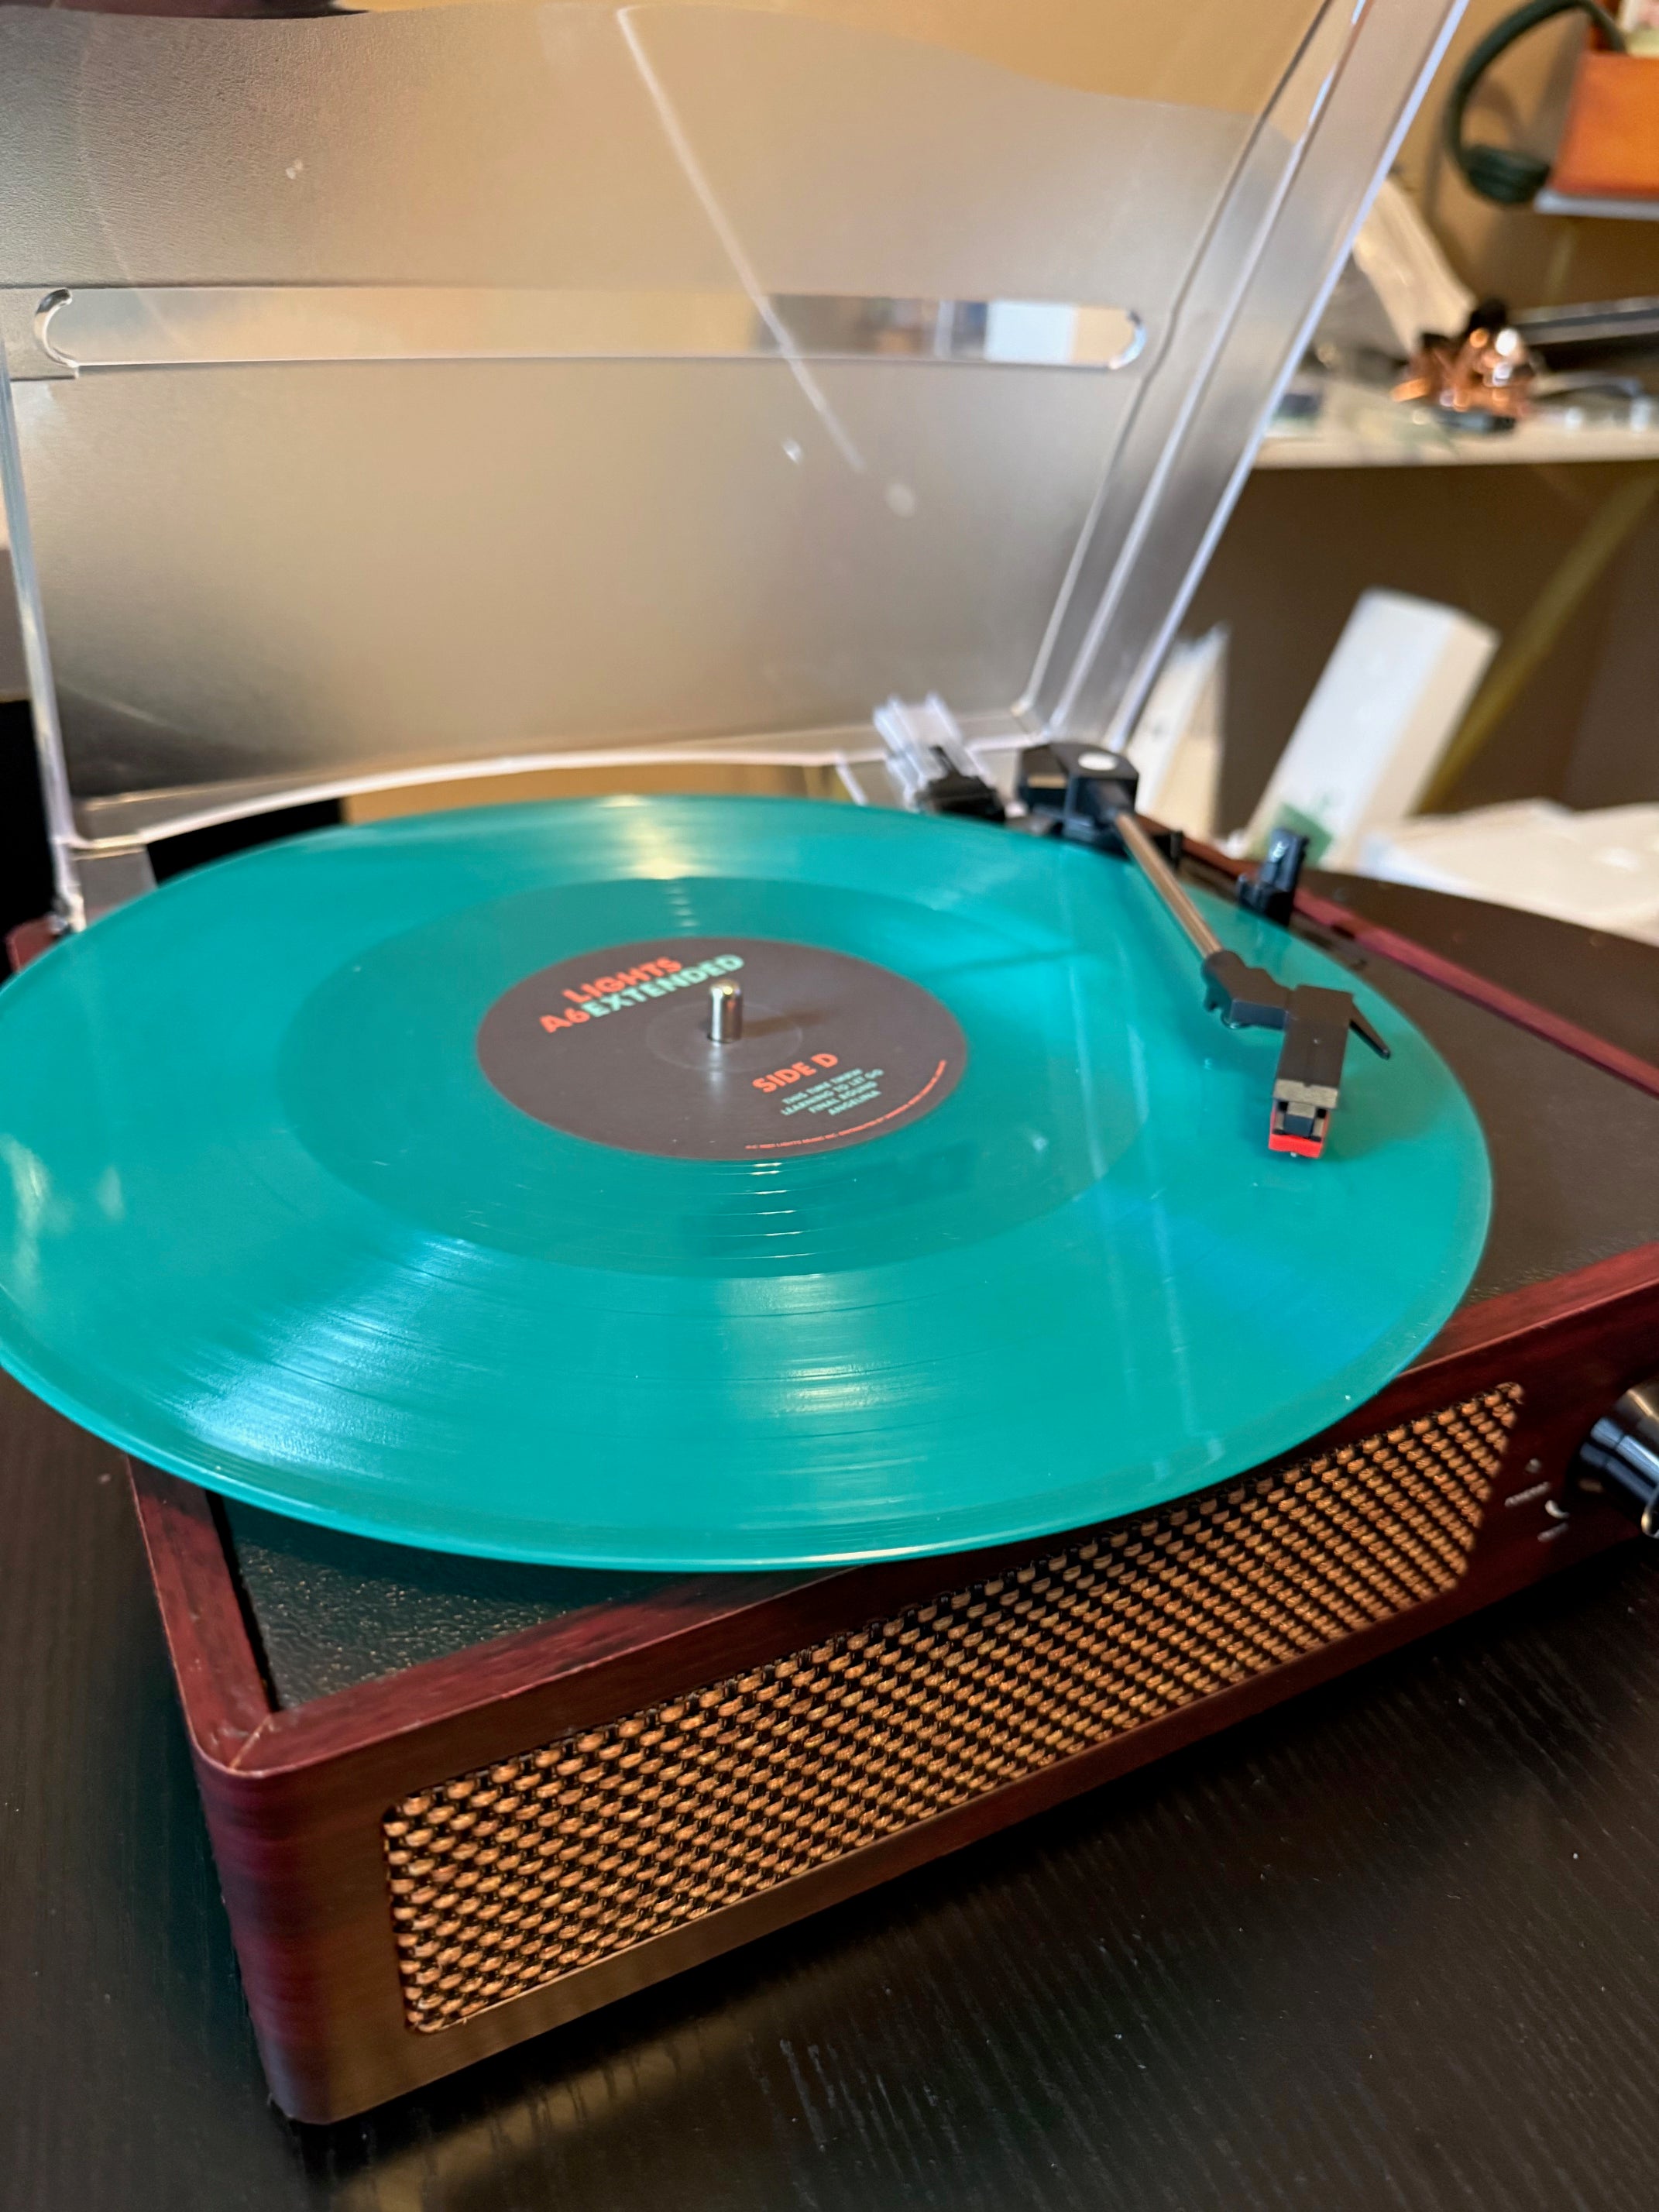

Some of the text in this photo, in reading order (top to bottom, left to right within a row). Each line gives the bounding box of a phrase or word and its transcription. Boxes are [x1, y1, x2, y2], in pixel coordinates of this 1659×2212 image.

[562, 956, 682, 1004] LIGHTS
[752, 1062, 817, 1093] SIDE
[811, 1053, 838, 1068] D
